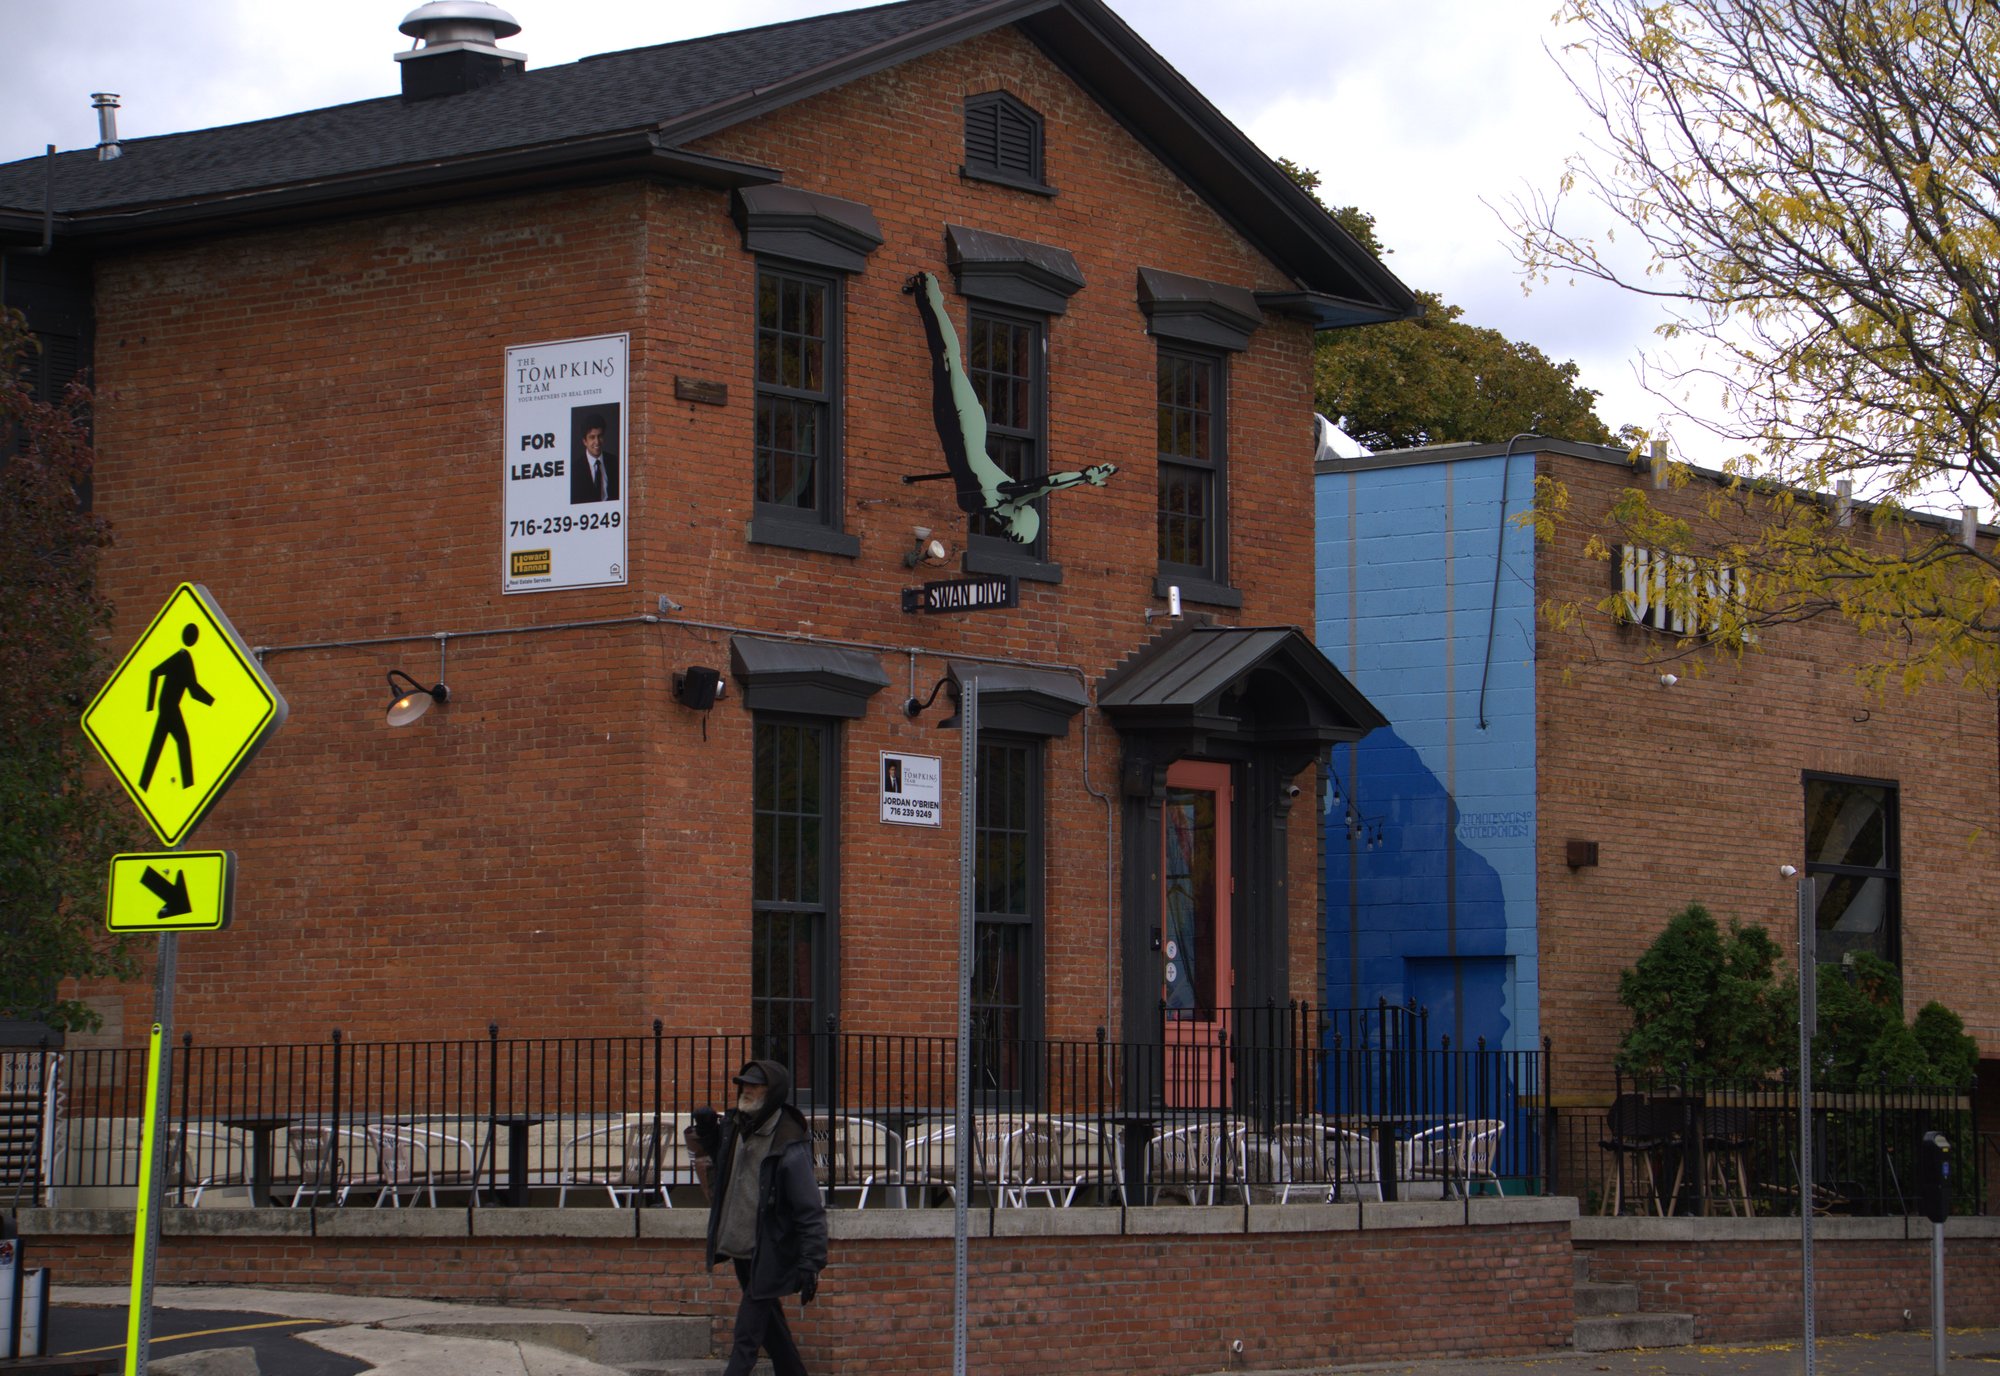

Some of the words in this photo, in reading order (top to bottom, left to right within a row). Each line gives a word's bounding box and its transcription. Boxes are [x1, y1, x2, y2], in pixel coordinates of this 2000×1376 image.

[517, 358, 536, 366] THE
[517, 356, 615, 383] TOMPKINS
[518, 382, 550, 394] TEAM
[521, 433, 555, 451] FOR
[511, 460, 565, 480] LEASE
[510, 511, 621, 537] 716-239-9249
[929, 585, 969, 609] SWAN
[976, 581, 1007, 605] DIVE
[903, 771, 938, 783] TOMPKINS
[883, 797, 911, 806] JORDAN
[911, 800, 939, 809] O'BRIEN
[890, 807, 901, 816] 716
[902, 808, 914, 816] 239
[915, 810, 932, 818] 9249
[1460, 824, 1529, 839] STEPHEN
